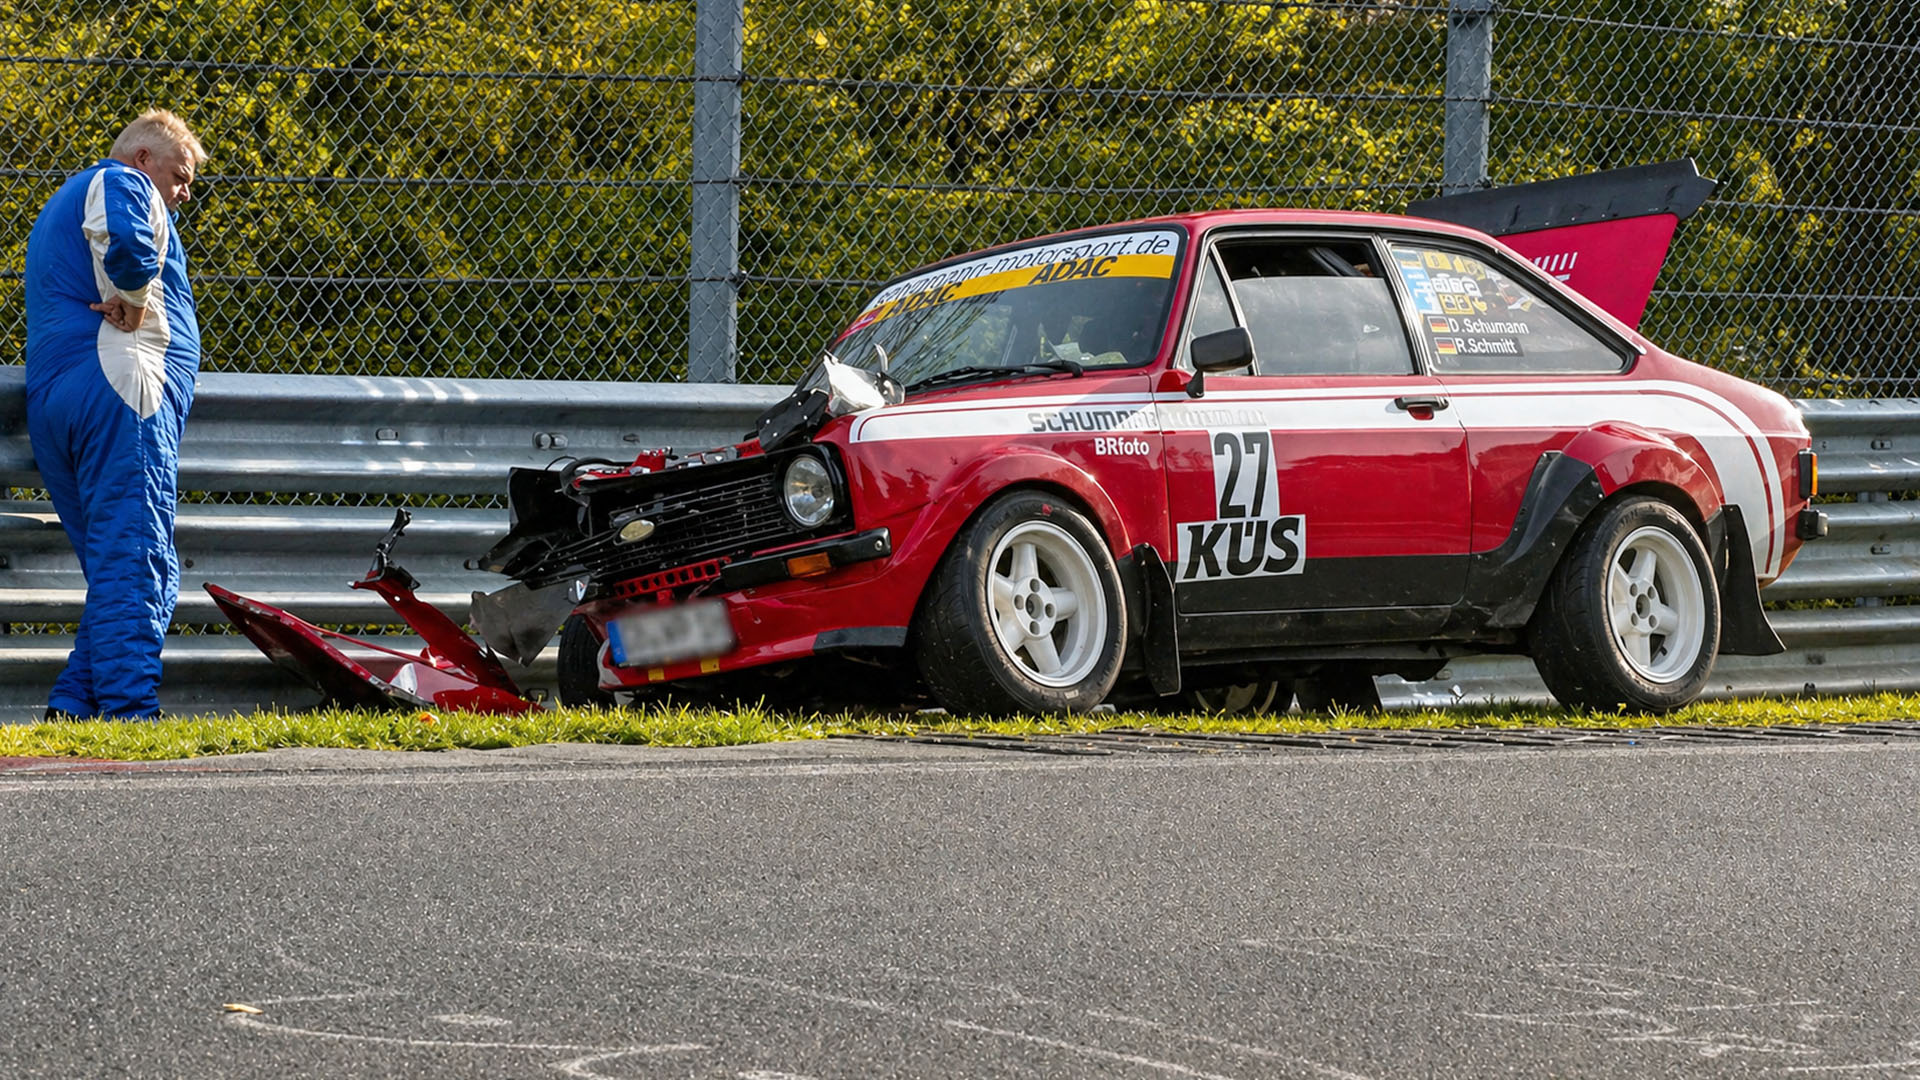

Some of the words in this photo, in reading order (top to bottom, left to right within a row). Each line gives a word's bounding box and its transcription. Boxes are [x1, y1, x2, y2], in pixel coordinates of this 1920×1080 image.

[882, 281, 963, 320] ADAC
[1028, 256, 1118, 285] ADAC
[1455, 338, 1518, 354] R.Schmitt
[1094, 437, 1150, 456] BRfoto
[1214, 432, 1269, 519] 27
[1183, 517, 1300, 579] KÜS
